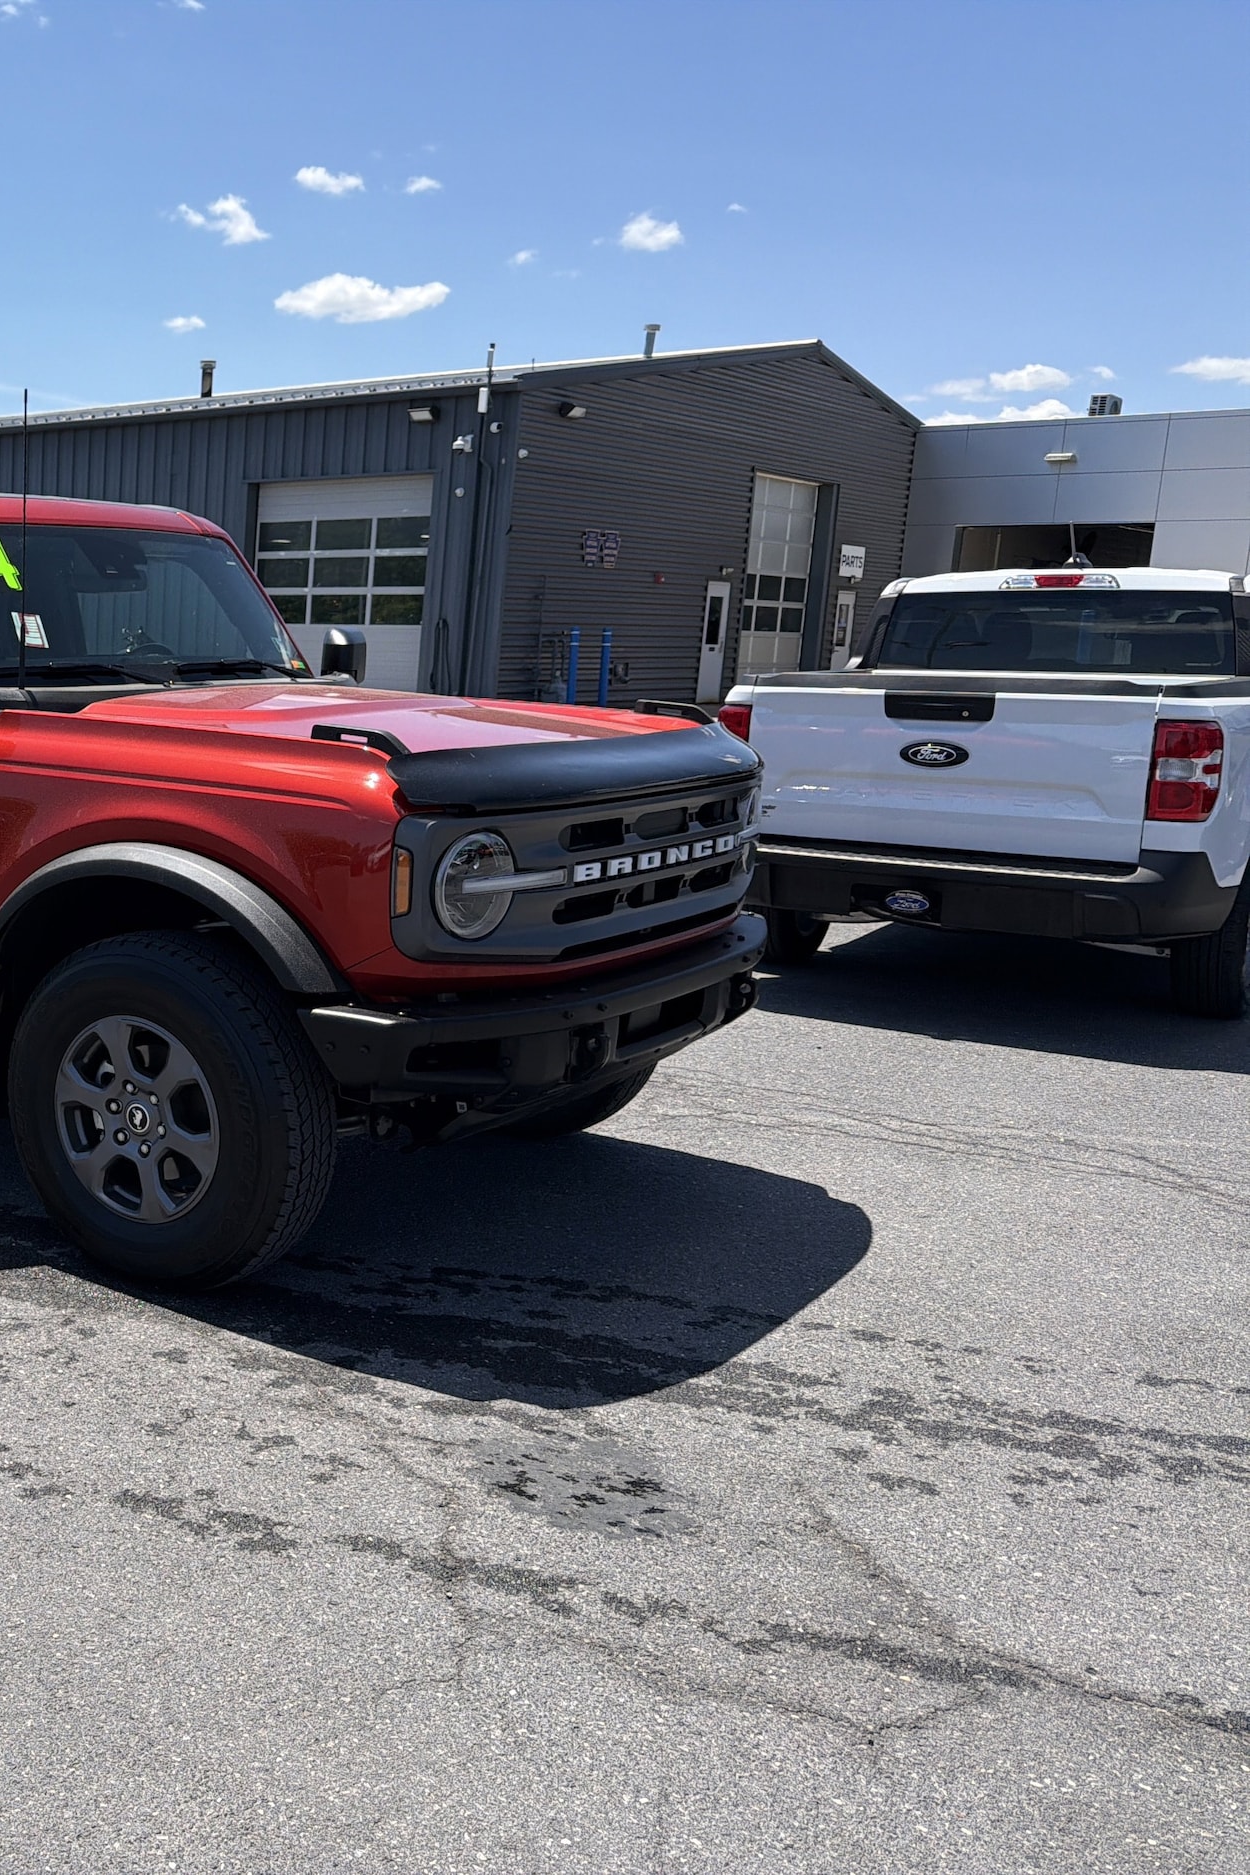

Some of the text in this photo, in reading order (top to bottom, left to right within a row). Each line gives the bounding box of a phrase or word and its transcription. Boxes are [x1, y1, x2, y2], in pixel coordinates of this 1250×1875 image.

[841, 554, 863, 569] PARTS
[916, 748, 948, 761] Ford
[573, 834, 735, 883] BRONCO
